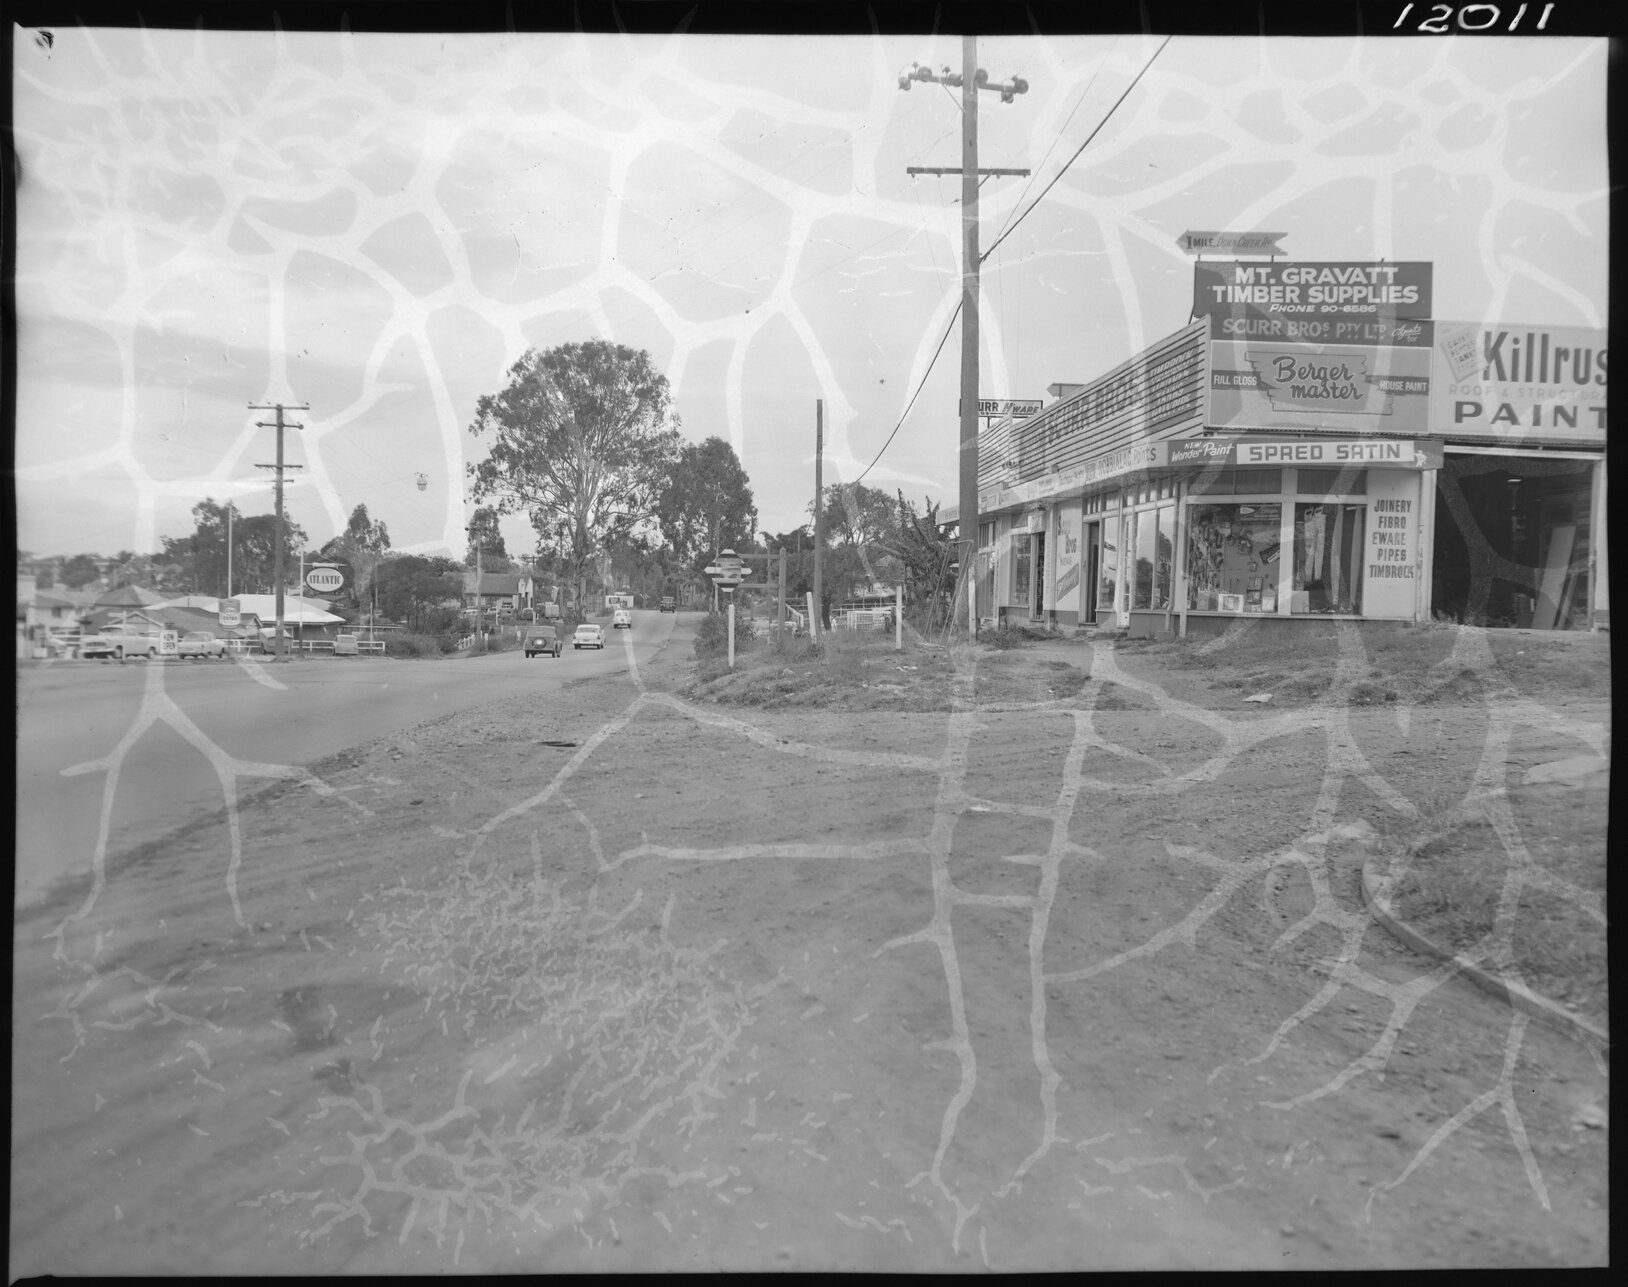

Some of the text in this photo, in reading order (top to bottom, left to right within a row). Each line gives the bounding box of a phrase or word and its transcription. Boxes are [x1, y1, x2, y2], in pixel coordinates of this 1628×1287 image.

[1393, 3, 1555, 32] 12011
[1186, 235, 1193, 249] 1
[1193, 237, 1214, 248] MILE
[1235, 267, 1399, 285] MT. GRAVATT
[1212, 285, 1420, 304] TIMBER SUPPLIES
[1269, 304, 1315, 313] PHONE
[1222, 318, 1282, 336] SCURR
[1272, 355, 1354, 388] Berger
[1213, 375, 1258, 386] FULL GLOSS
[1379, 380, 1429, 391] HOUSE PAINT
[1290, 382, 1365, 400] master
[1449, 384, 1493, 396] ROOF
[1502, 388, 1510, 398] &
[1183, 440, 1201, 449] NEW
[1171, 442, 1234, 462] Wonder Paint
[1250, 443, 1401, 461] SPRED SATIN
[1374, 499, 1412, 513] JOINERY
[1378, 516, 1407, 529] FIBRO
[1372, 531, 1406, 545] EWARE
[1377, 548, 1407, 561] PIPES
[1369, 564, 1415, 578] TIMBROCK
[309, 575, 342, 585] ATLANTIC
